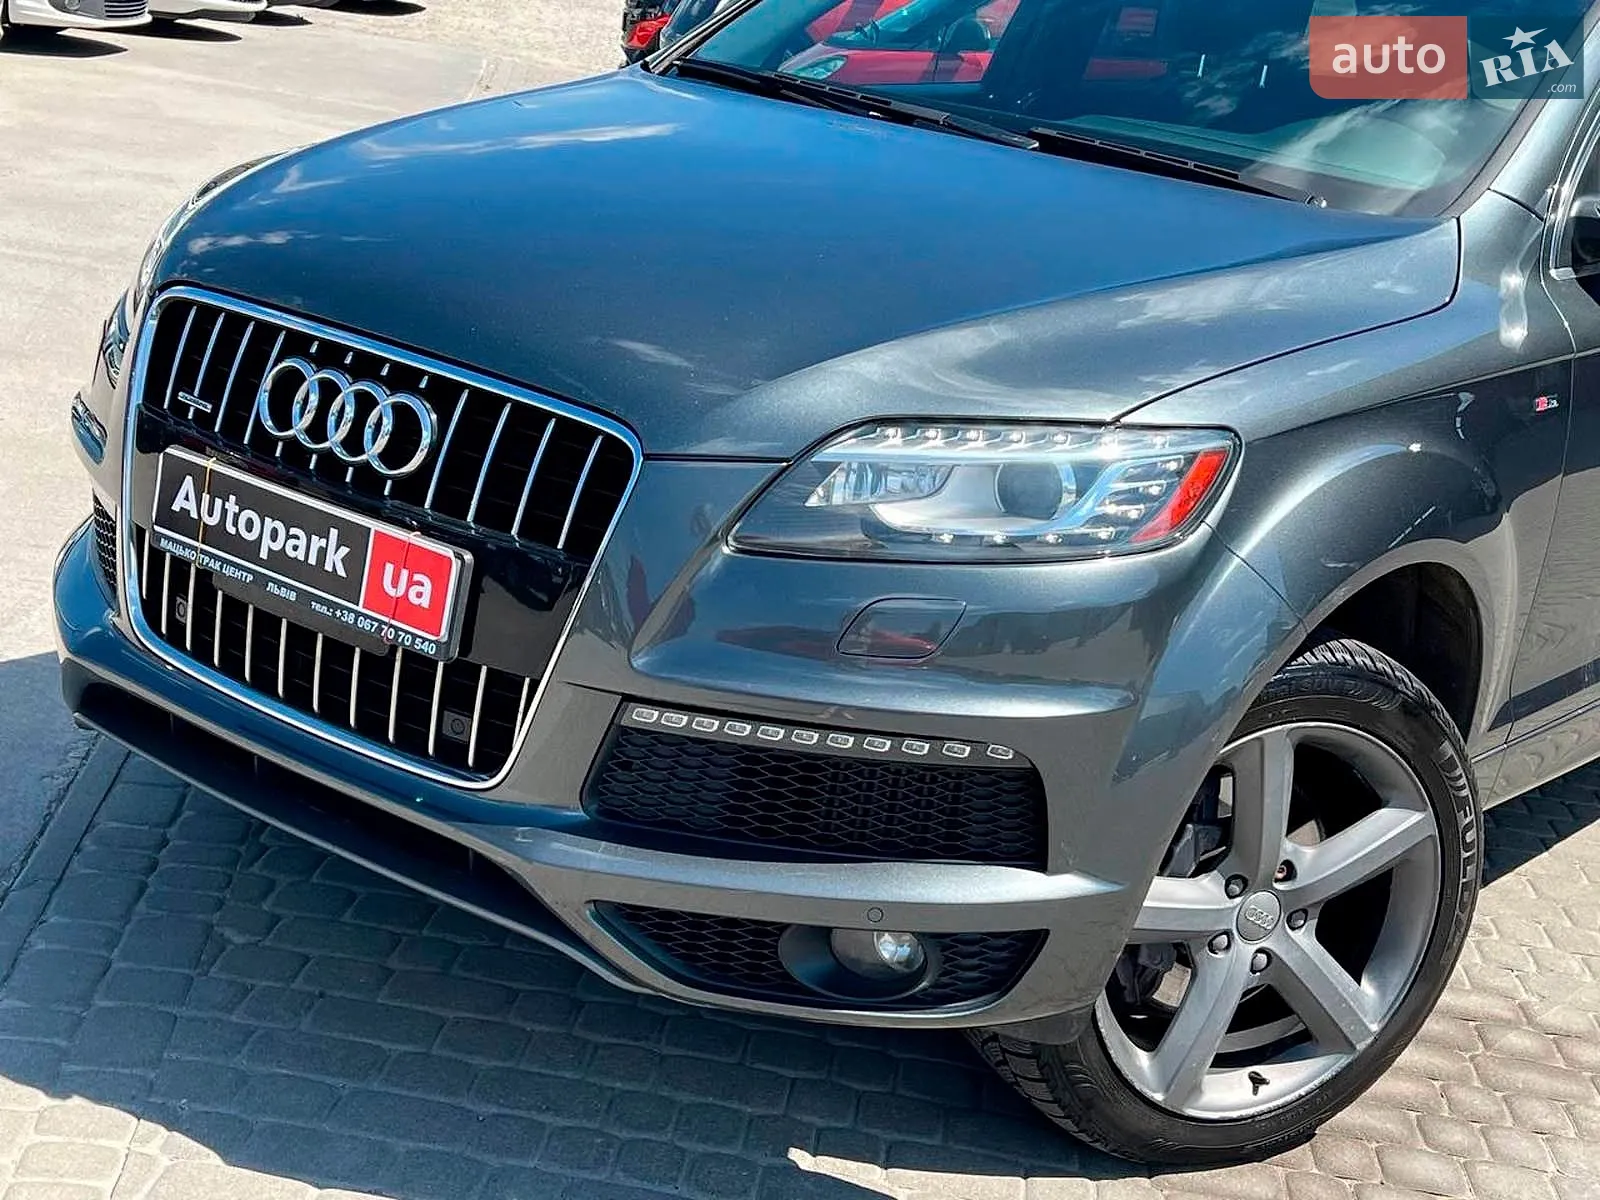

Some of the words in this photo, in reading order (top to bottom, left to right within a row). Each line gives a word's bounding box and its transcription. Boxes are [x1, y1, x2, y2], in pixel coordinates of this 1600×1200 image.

[160, 537, 197, 561] МАЦЬКО
[199, 554, 222, 572] ТРАК
[222, 563, 254, 584] ЦЕНТР
[266, 581, 297, 601] ЛЬВІВ
[335, 609, 355, 625] +38
[357, 616, 378, 633] 067
[381, 624, 395, 640] 70
[398, 631, 412, 646] 70
[415, 639, 437, 655] 540
[171, 475, 350, 578] Autopark
[382, 561, 433, 609] ua
